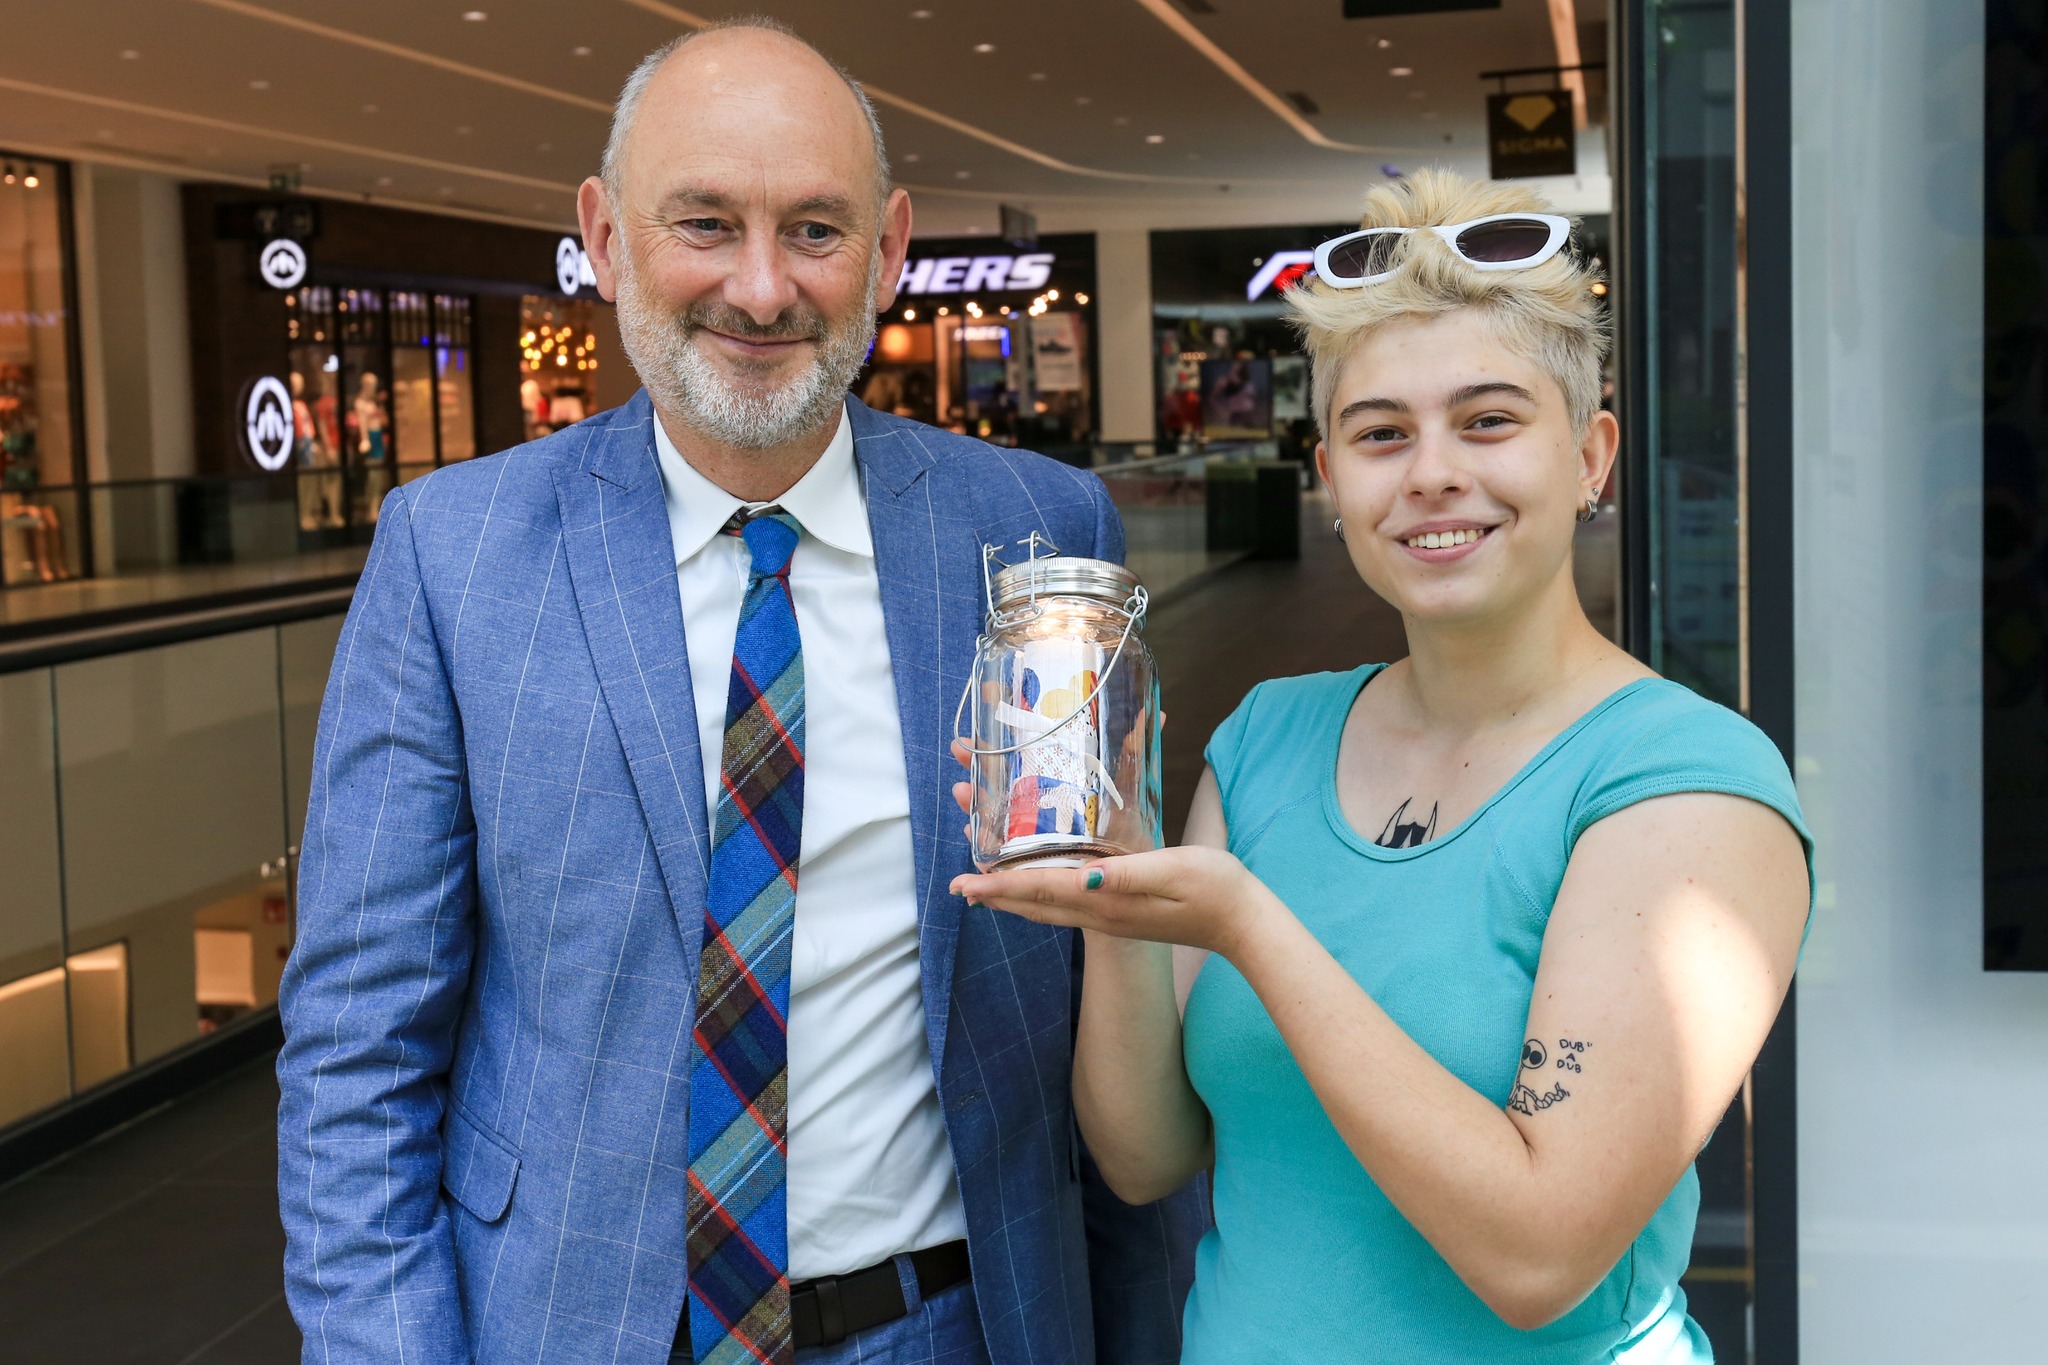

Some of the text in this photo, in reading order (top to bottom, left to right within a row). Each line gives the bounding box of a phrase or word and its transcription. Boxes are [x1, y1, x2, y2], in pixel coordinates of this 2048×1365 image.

[1559, 1038, 1584, 1053] DUB
[1566, 1053, 1576, 1062] A
[1556, 1059, 1581, 1074] DUB
